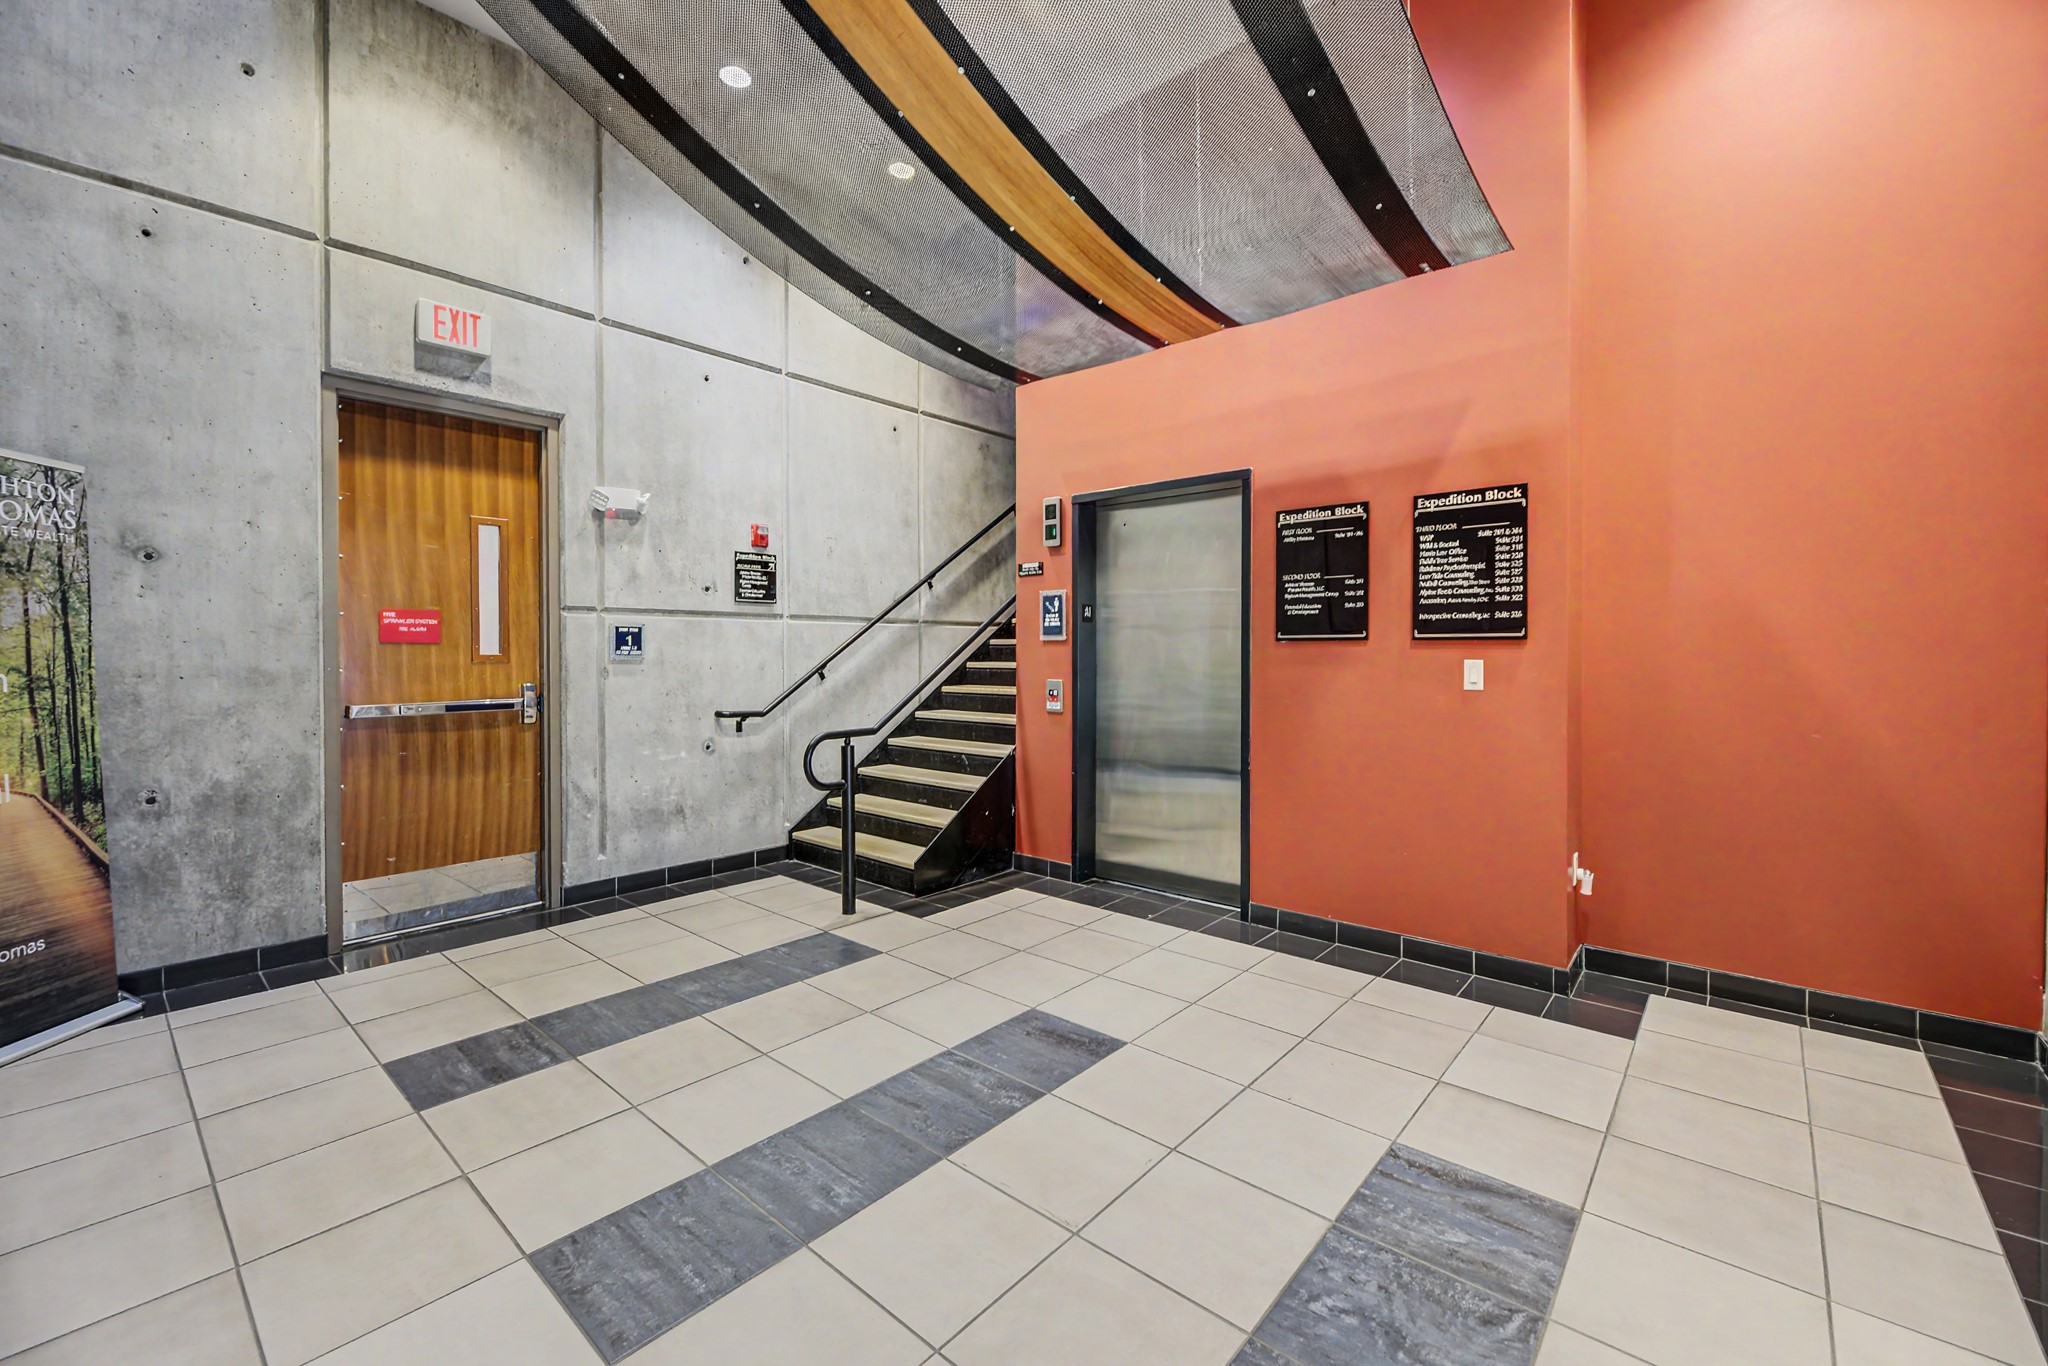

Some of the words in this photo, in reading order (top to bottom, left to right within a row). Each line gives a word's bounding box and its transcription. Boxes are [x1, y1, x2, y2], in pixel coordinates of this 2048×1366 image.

[433, 304, 481, 348] EXIT
[1417, 495, 1482, 512] Expedition
[1485, 487, 1522, 500] Block
[0, 499, 77, 529] OMAS
[1279, 508, 1332, 524] Expedition
[1334, 504, 1364, 516] Block
[23, 528, 74, 544] WEALTH
[625, 634, 632, 646] 1
[0, 939, 46, 963] omas
